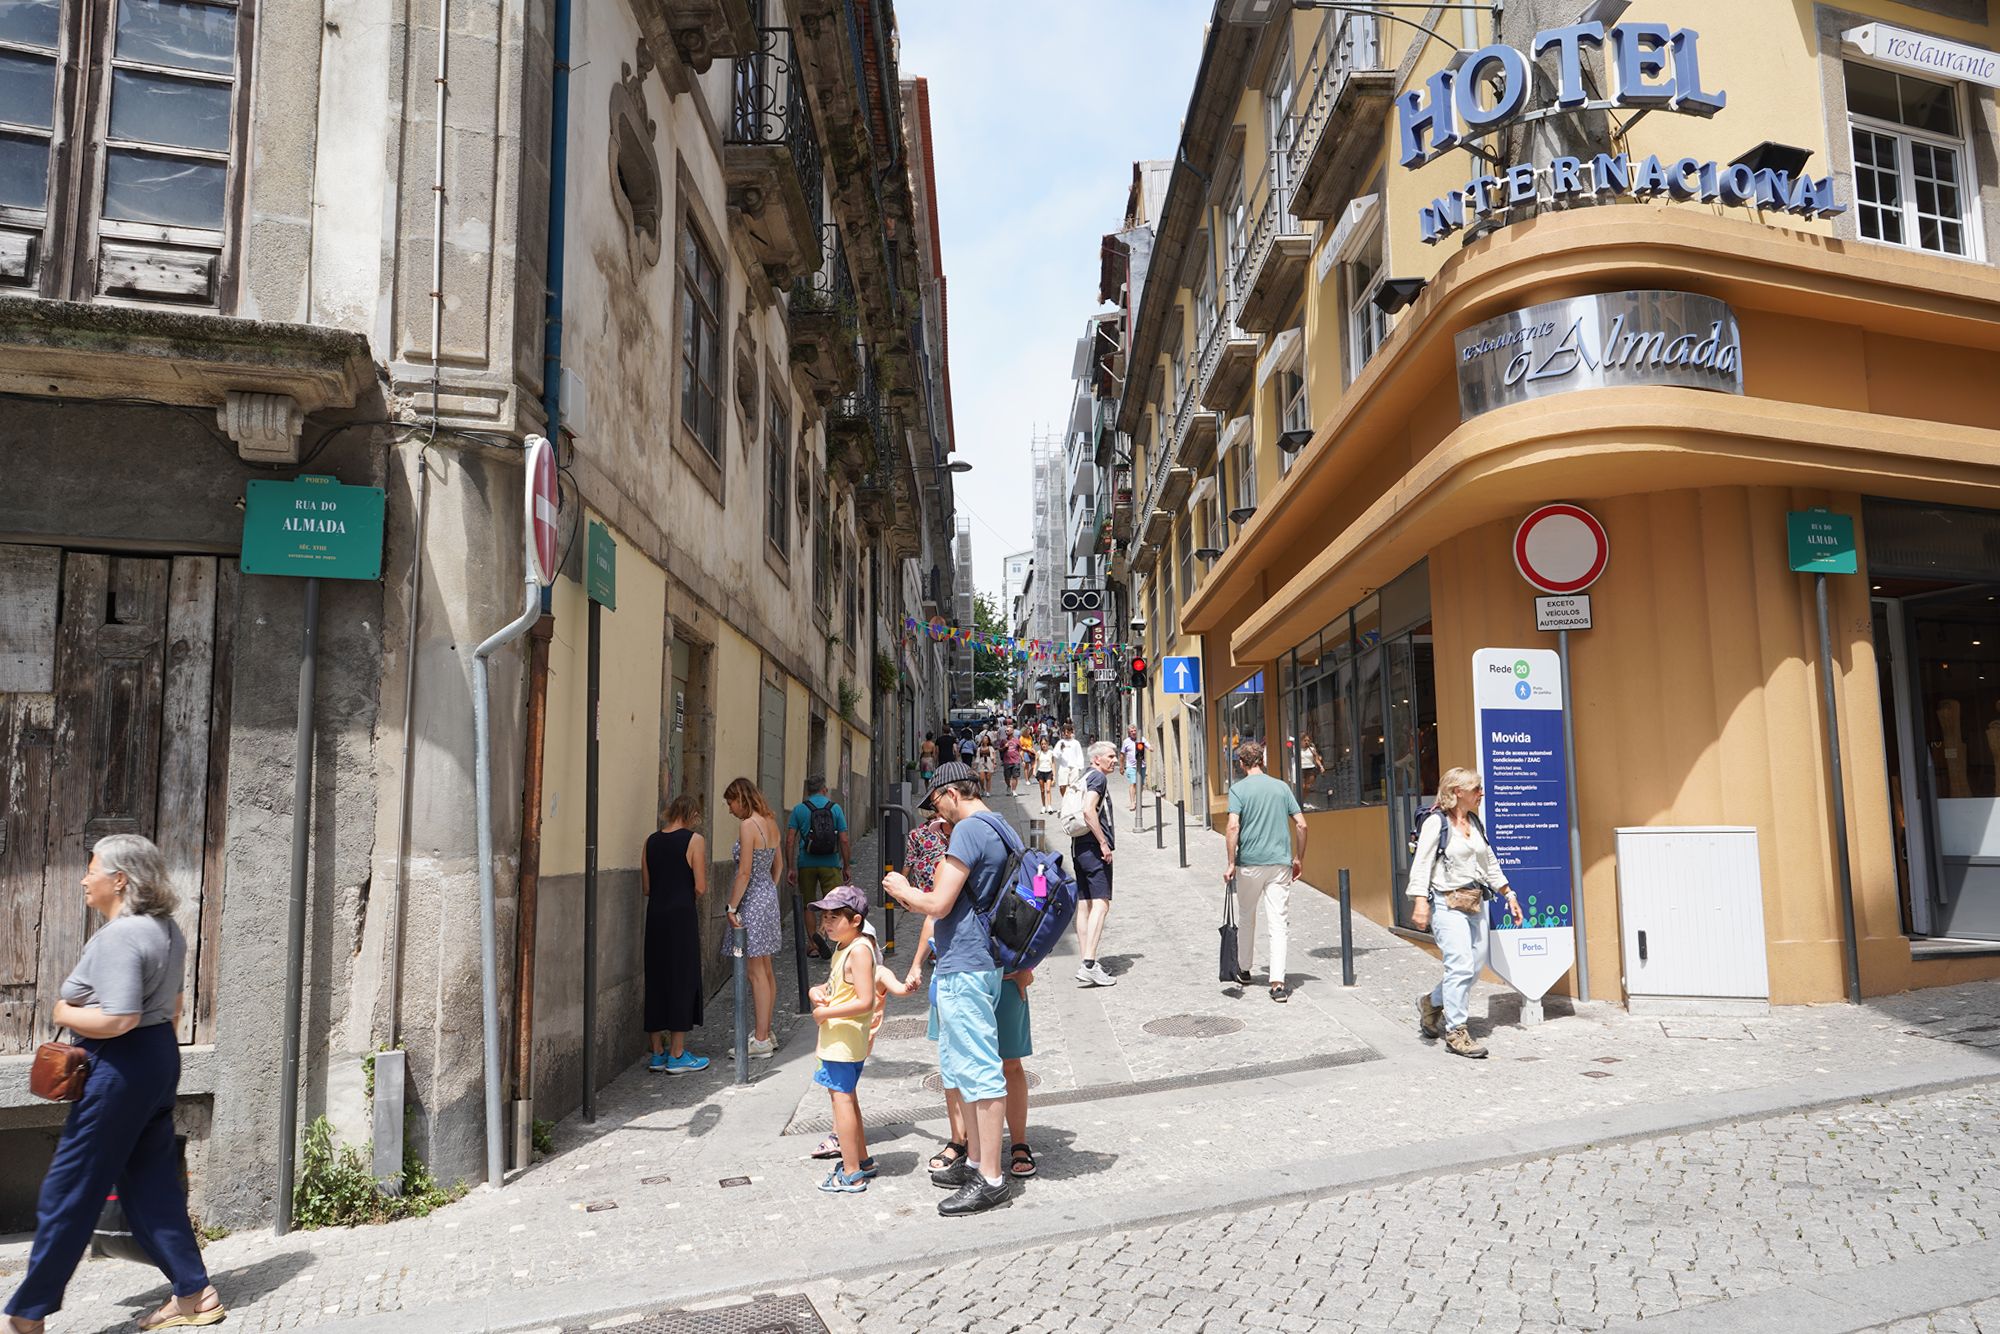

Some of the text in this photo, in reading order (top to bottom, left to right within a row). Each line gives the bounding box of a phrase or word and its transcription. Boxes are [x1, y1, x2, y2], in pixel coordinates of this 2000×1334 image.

[1887, 37, 1995, 79] restaurante
[1395, 21, 1727, 171] HOTEL
[1418, 153, 1847, 246] INTERNACIONAL
[1462, 320, 1555, 363] restaurante
[1526, 313, 1738, 383] Almada
[305, 477, 330, 485] PORTO
[295, 499, 337, 512] RUA DO
[282, 517, 346, 534] ALMADA
[1811, 523, 1822, 531] RUA
[1807, 535, 1838, 545] ALMADA
[1546, 599, 1575, 608] EXCETO
[1545, 609, 1580, 617] VEÍCULOS
[1540, 617, 1589, 627] AUTORIZADOS
[1489, 664, 1528, 674] Rede 20
[1492, 732, 1531, 743] Movida
[1523, 943, 1544, 951] Porto.
